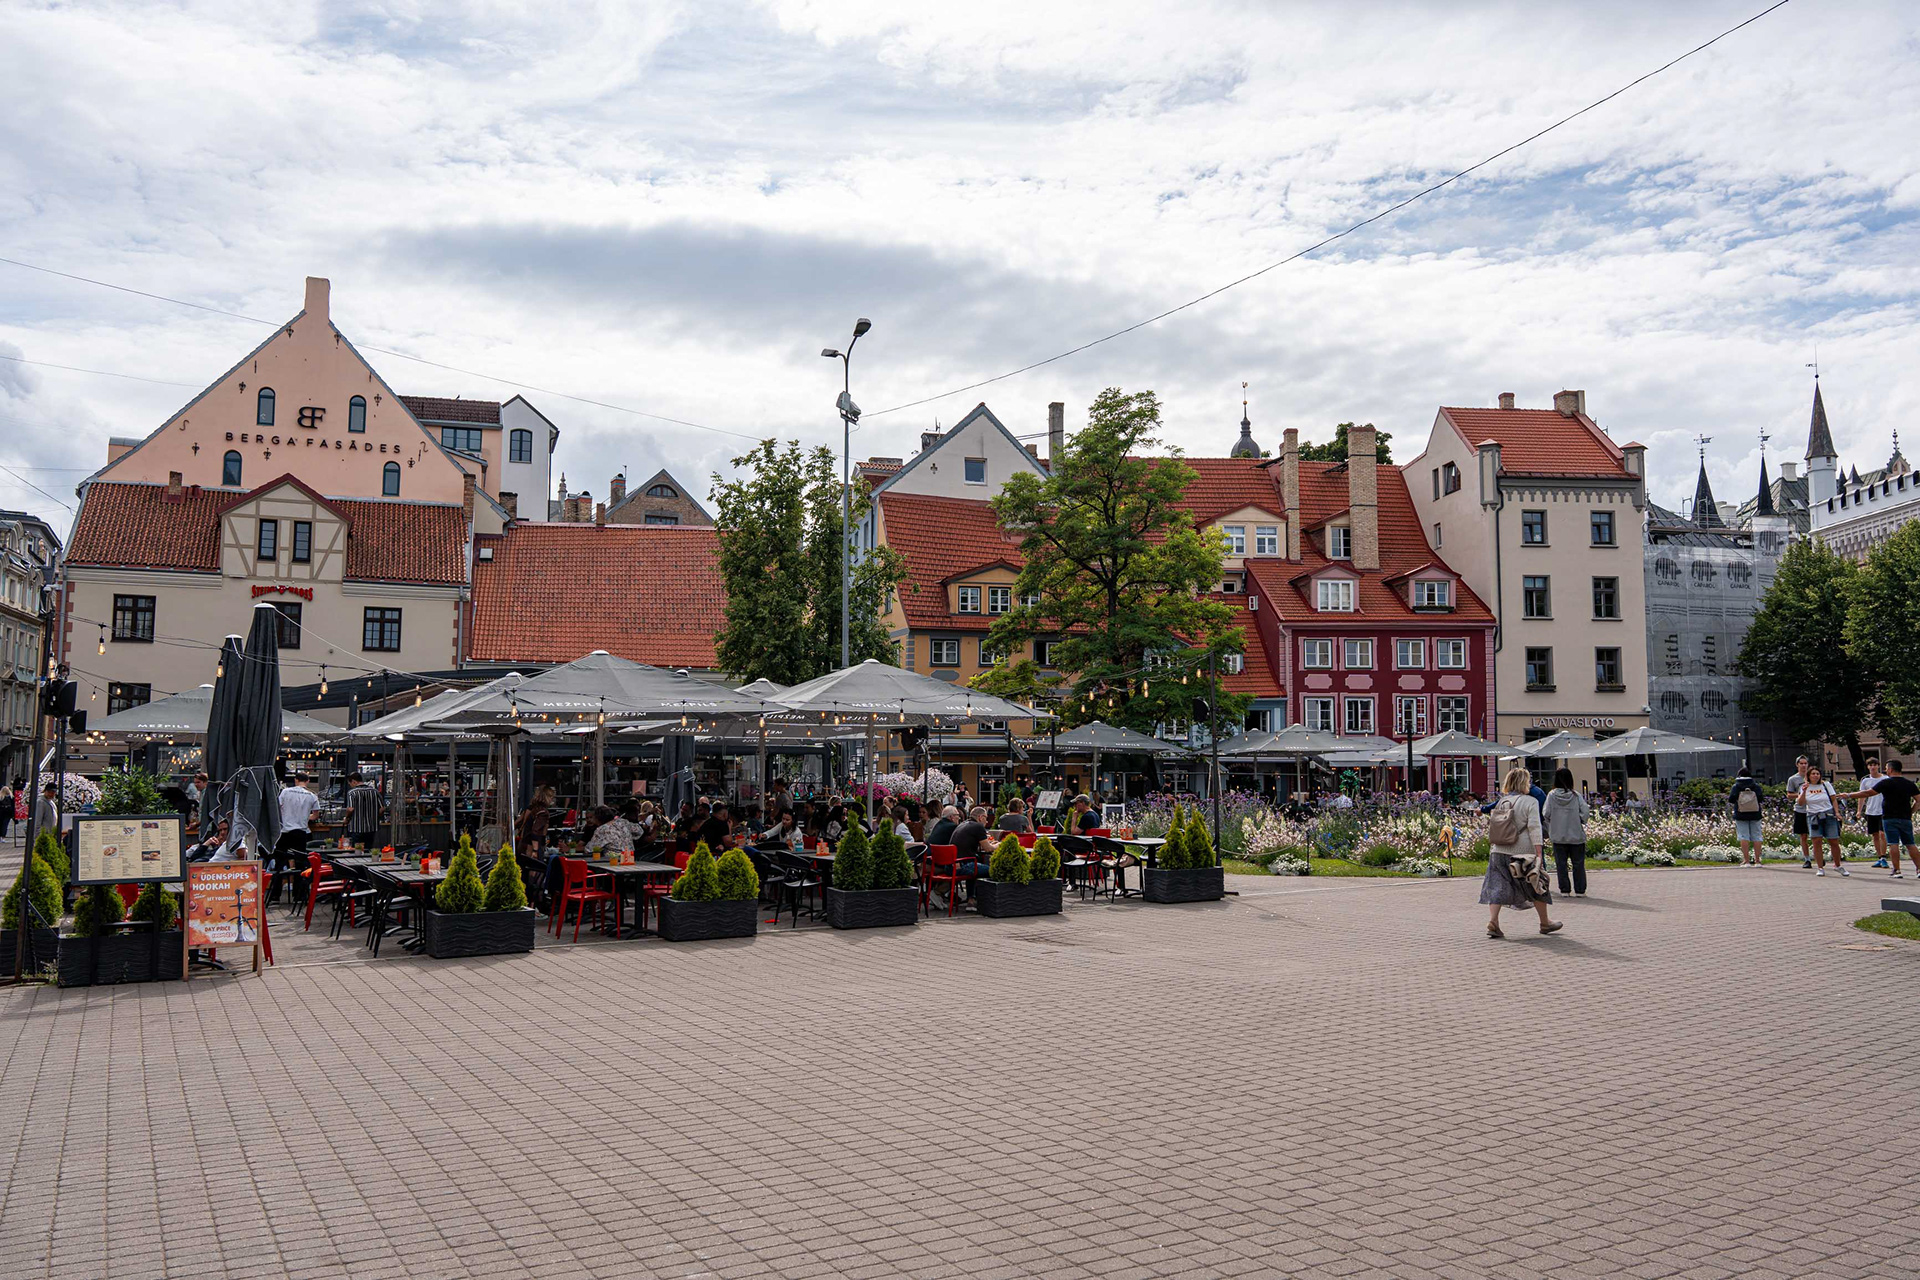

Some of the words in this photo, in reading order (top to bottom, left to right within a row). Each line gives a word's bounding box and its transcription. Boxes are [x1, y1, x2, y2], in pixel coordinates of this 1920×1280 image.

[225, 432, 297, 447] BERGA
[306, 438, 401, 454] FASĀDES
[1532, 717, 1615, 728] LATVIJASLOTO
[192, 882, 231, 891] HOOKAH
